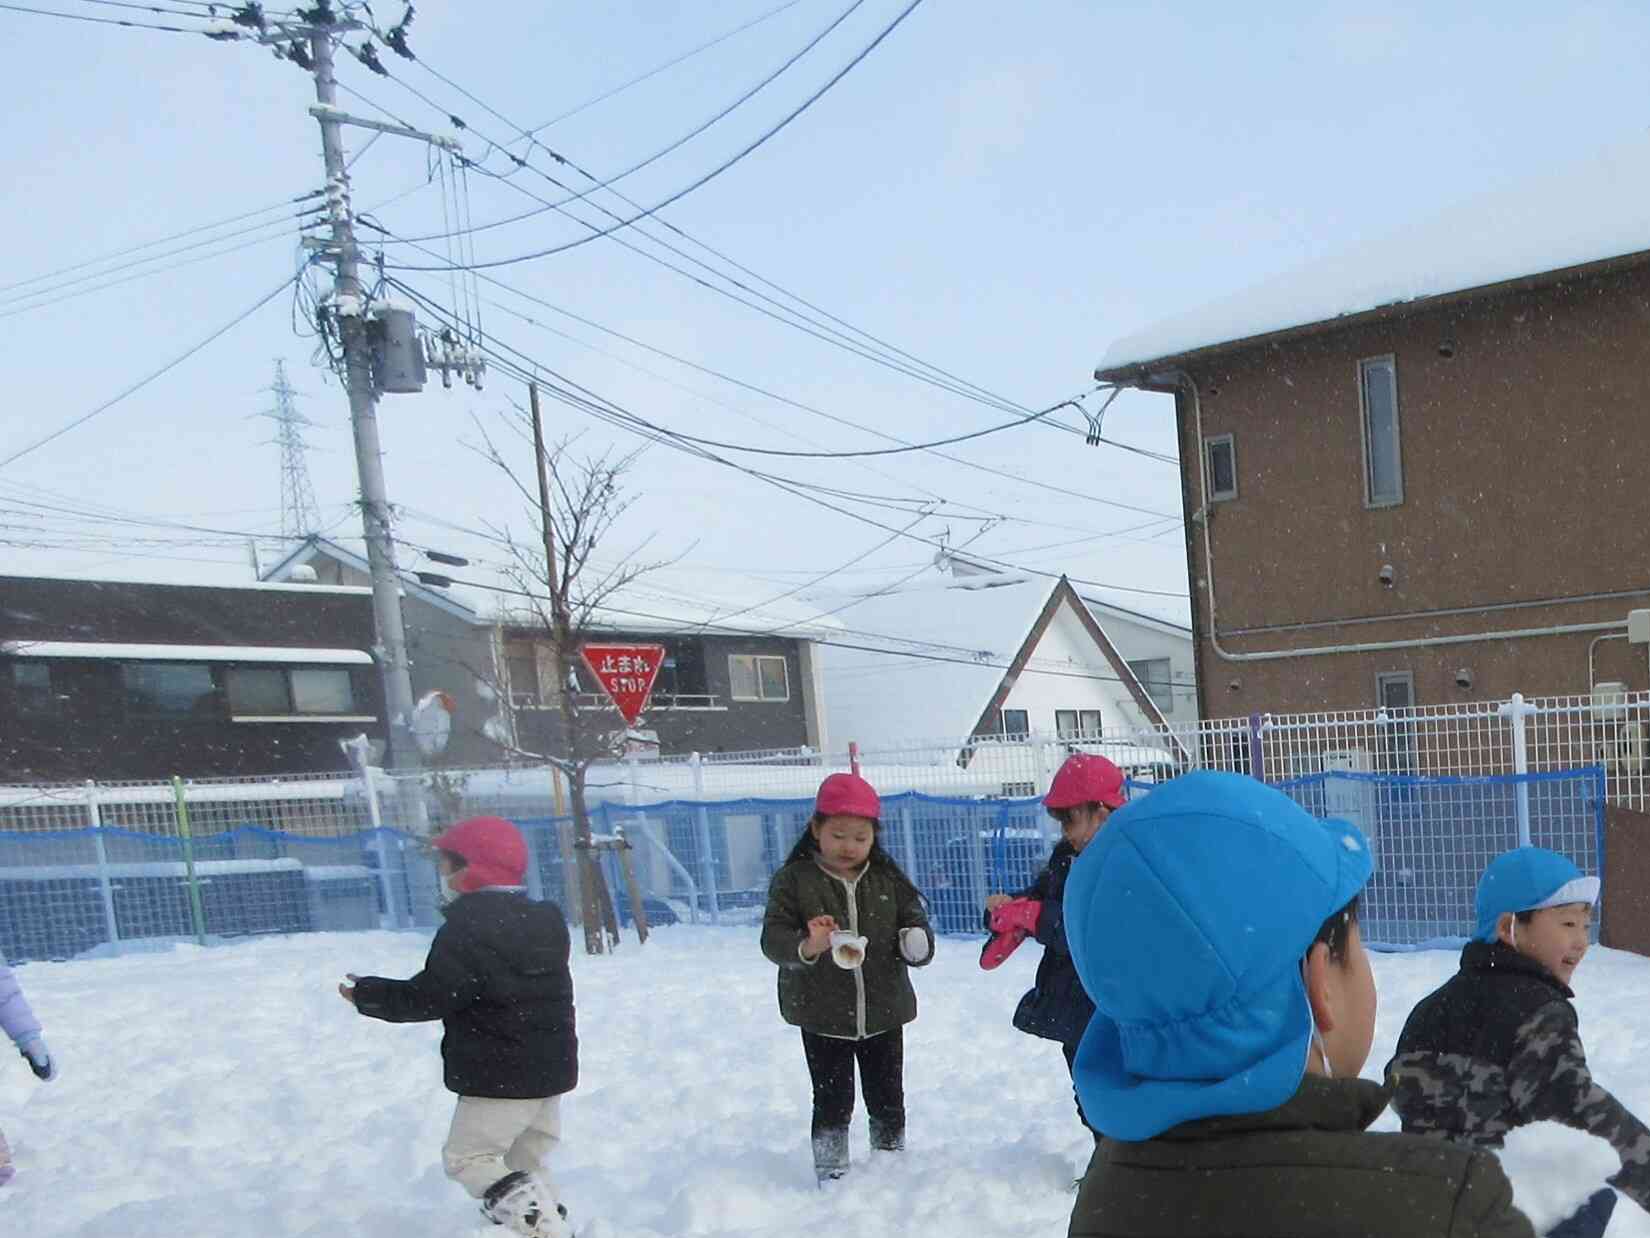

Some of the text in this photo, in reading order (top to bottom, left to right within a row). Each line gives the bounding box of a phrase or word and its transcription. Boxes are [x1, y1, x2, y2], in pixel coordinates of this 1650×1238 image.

[600, 655, 650, 674] 止まれ
[610, 678, 646, 692] STOP
